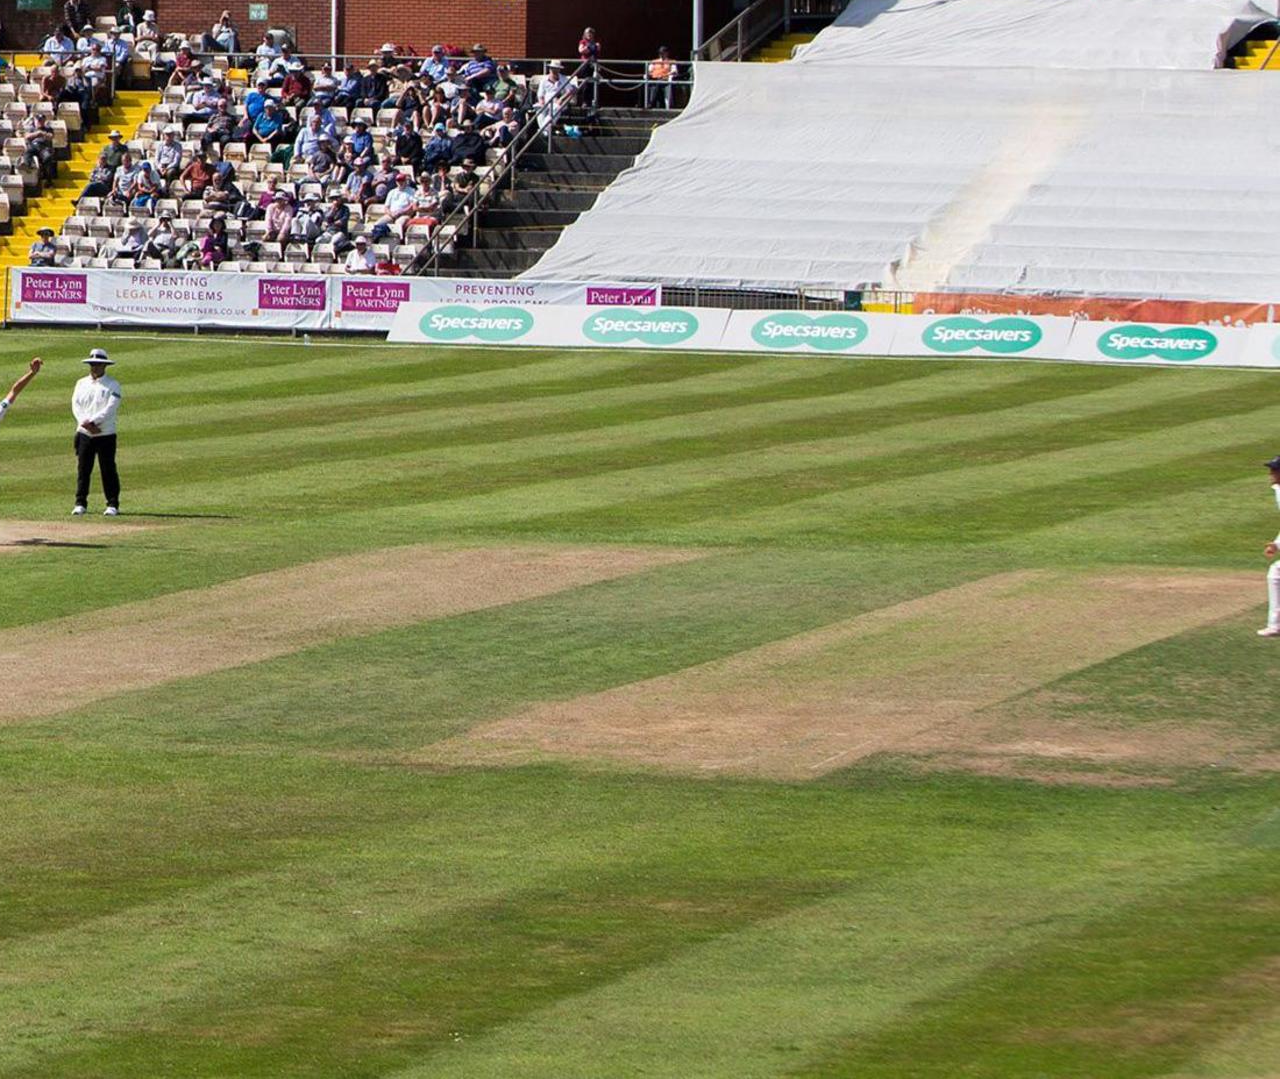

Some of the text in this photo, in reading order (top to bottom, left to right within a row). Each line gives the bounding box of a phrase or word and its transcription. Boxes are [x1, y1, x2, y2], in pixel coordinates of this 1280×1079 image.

[25, 276, 82, 294] Peter Lynn
[132, 275, 208, 287] PREVENTING
[34, 290, 82, 300] PARTNERS
[116, 289, 223, 301] LEGAL PROBLEMS
[263, 283, 321, 299] Peter Lynn
[346, 284, 405, 301] Peter Lynn
[455, 284, 535, 296] PREVENTING
[591, 290, 651, 305] Peter Lynn
[272, 297, 321, 306] PARTNERS
[429, 313, 523, 331] Specsavers
[592, 317, 688, 335] Specsavers
[761, 321, 858, 339] Specsavers
[932, 325, 1031, 343] Specsavers
[1107, 332, 1208, 351] Specsavers
